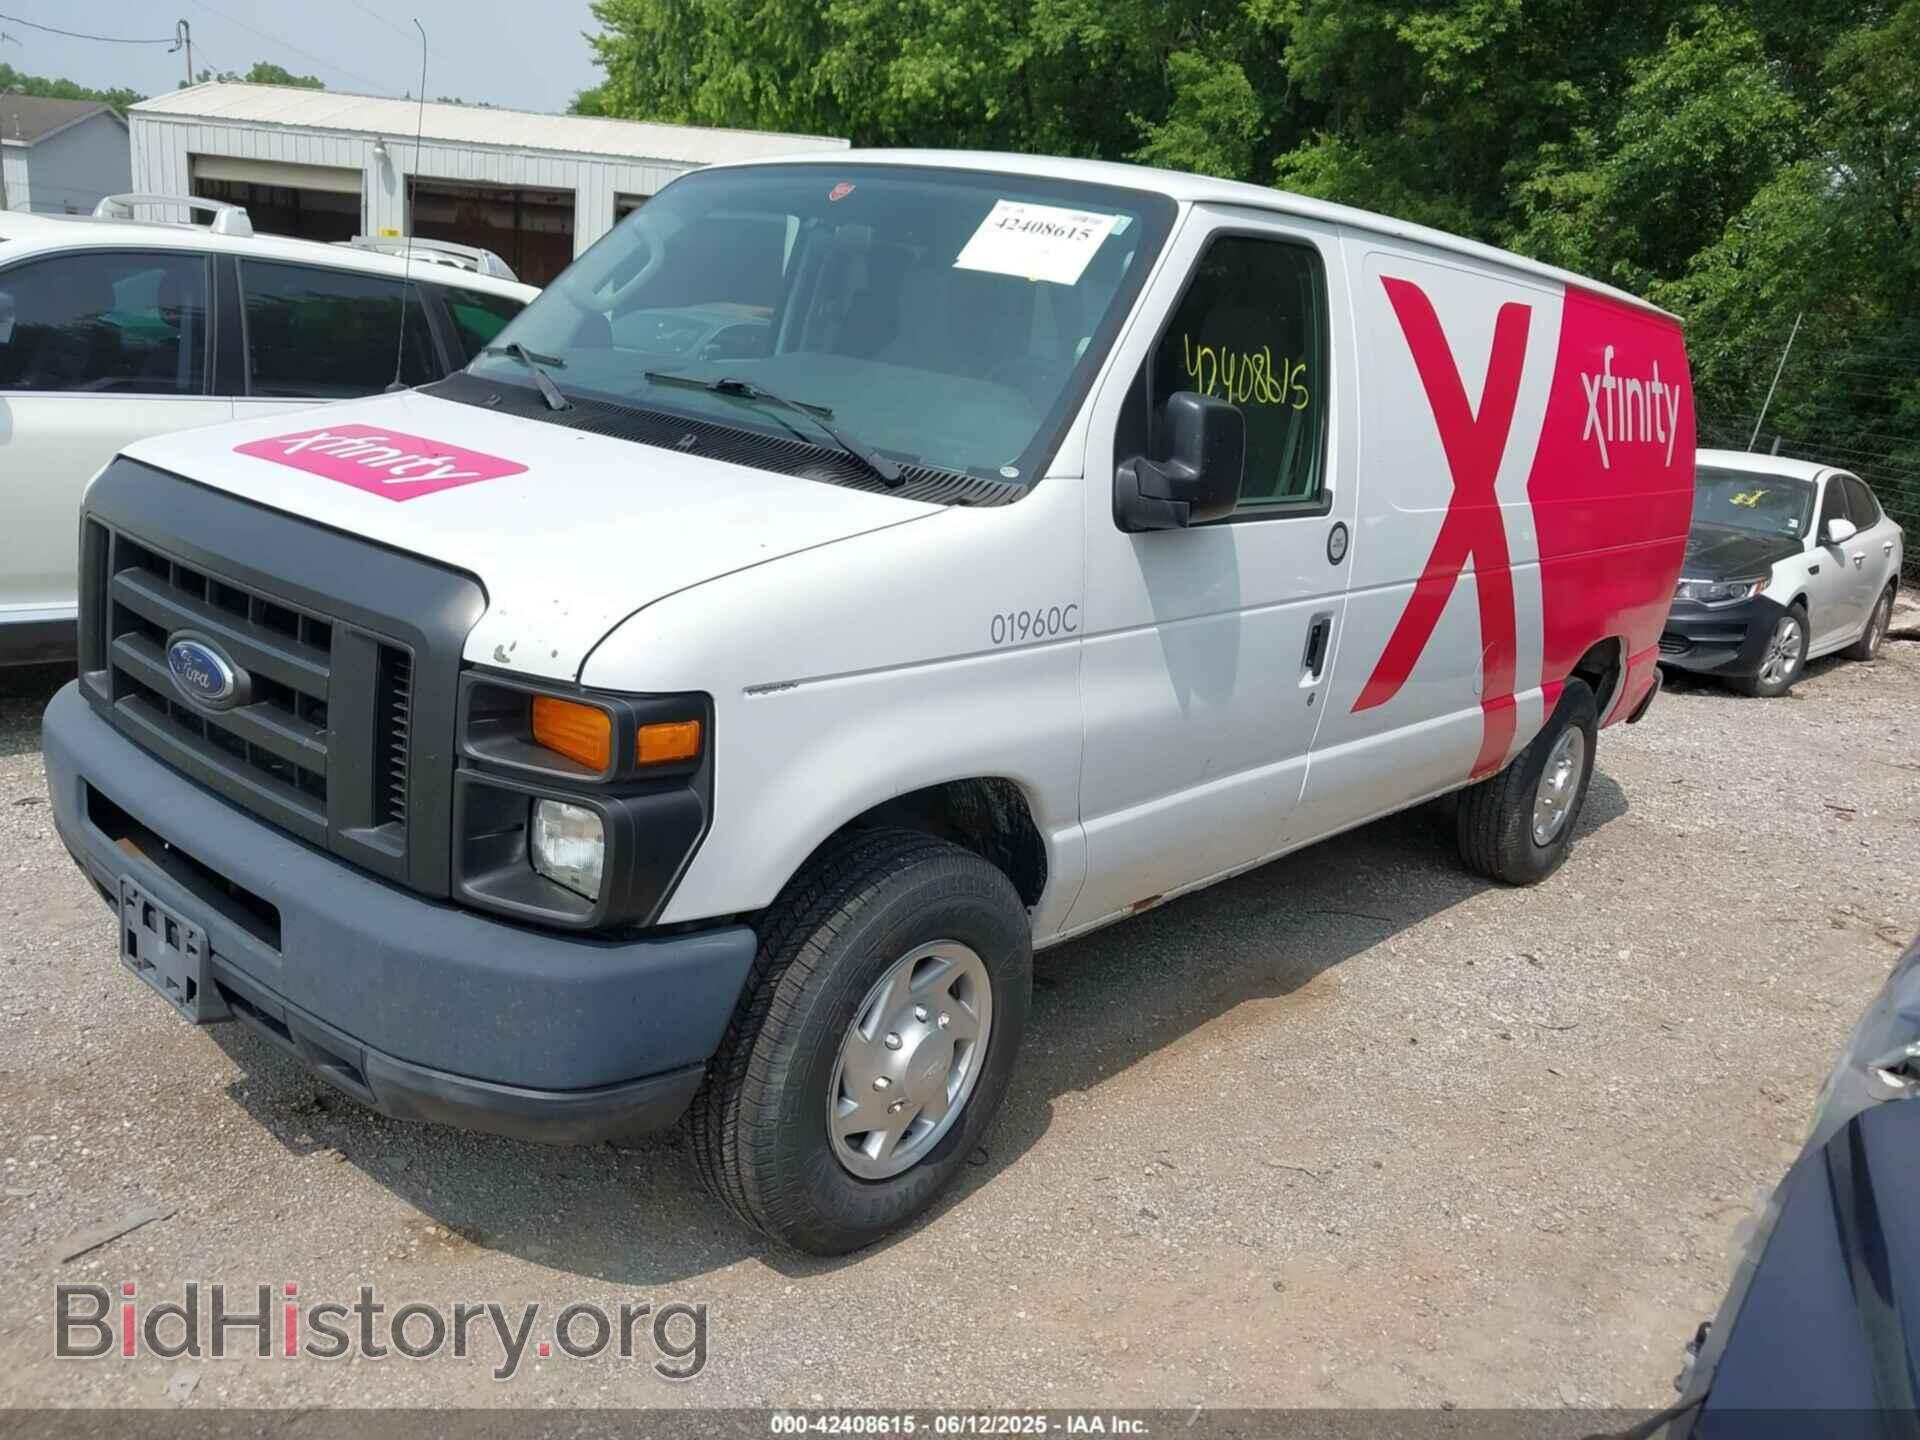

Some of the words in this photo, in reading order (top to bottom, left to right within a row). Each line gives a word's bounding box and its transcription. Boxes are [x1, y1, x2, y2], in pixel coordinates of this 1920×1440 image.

[995, 216, 1094, 241] 42408615
[1184, 333, 1310, 410] 42408615
[1580, 344, 1680, 469] xfinity
[278, 431, 481, 484] xfinity
[990, 603, 1078, 645] 01960C
[173, 648, 211, 689] Ford
